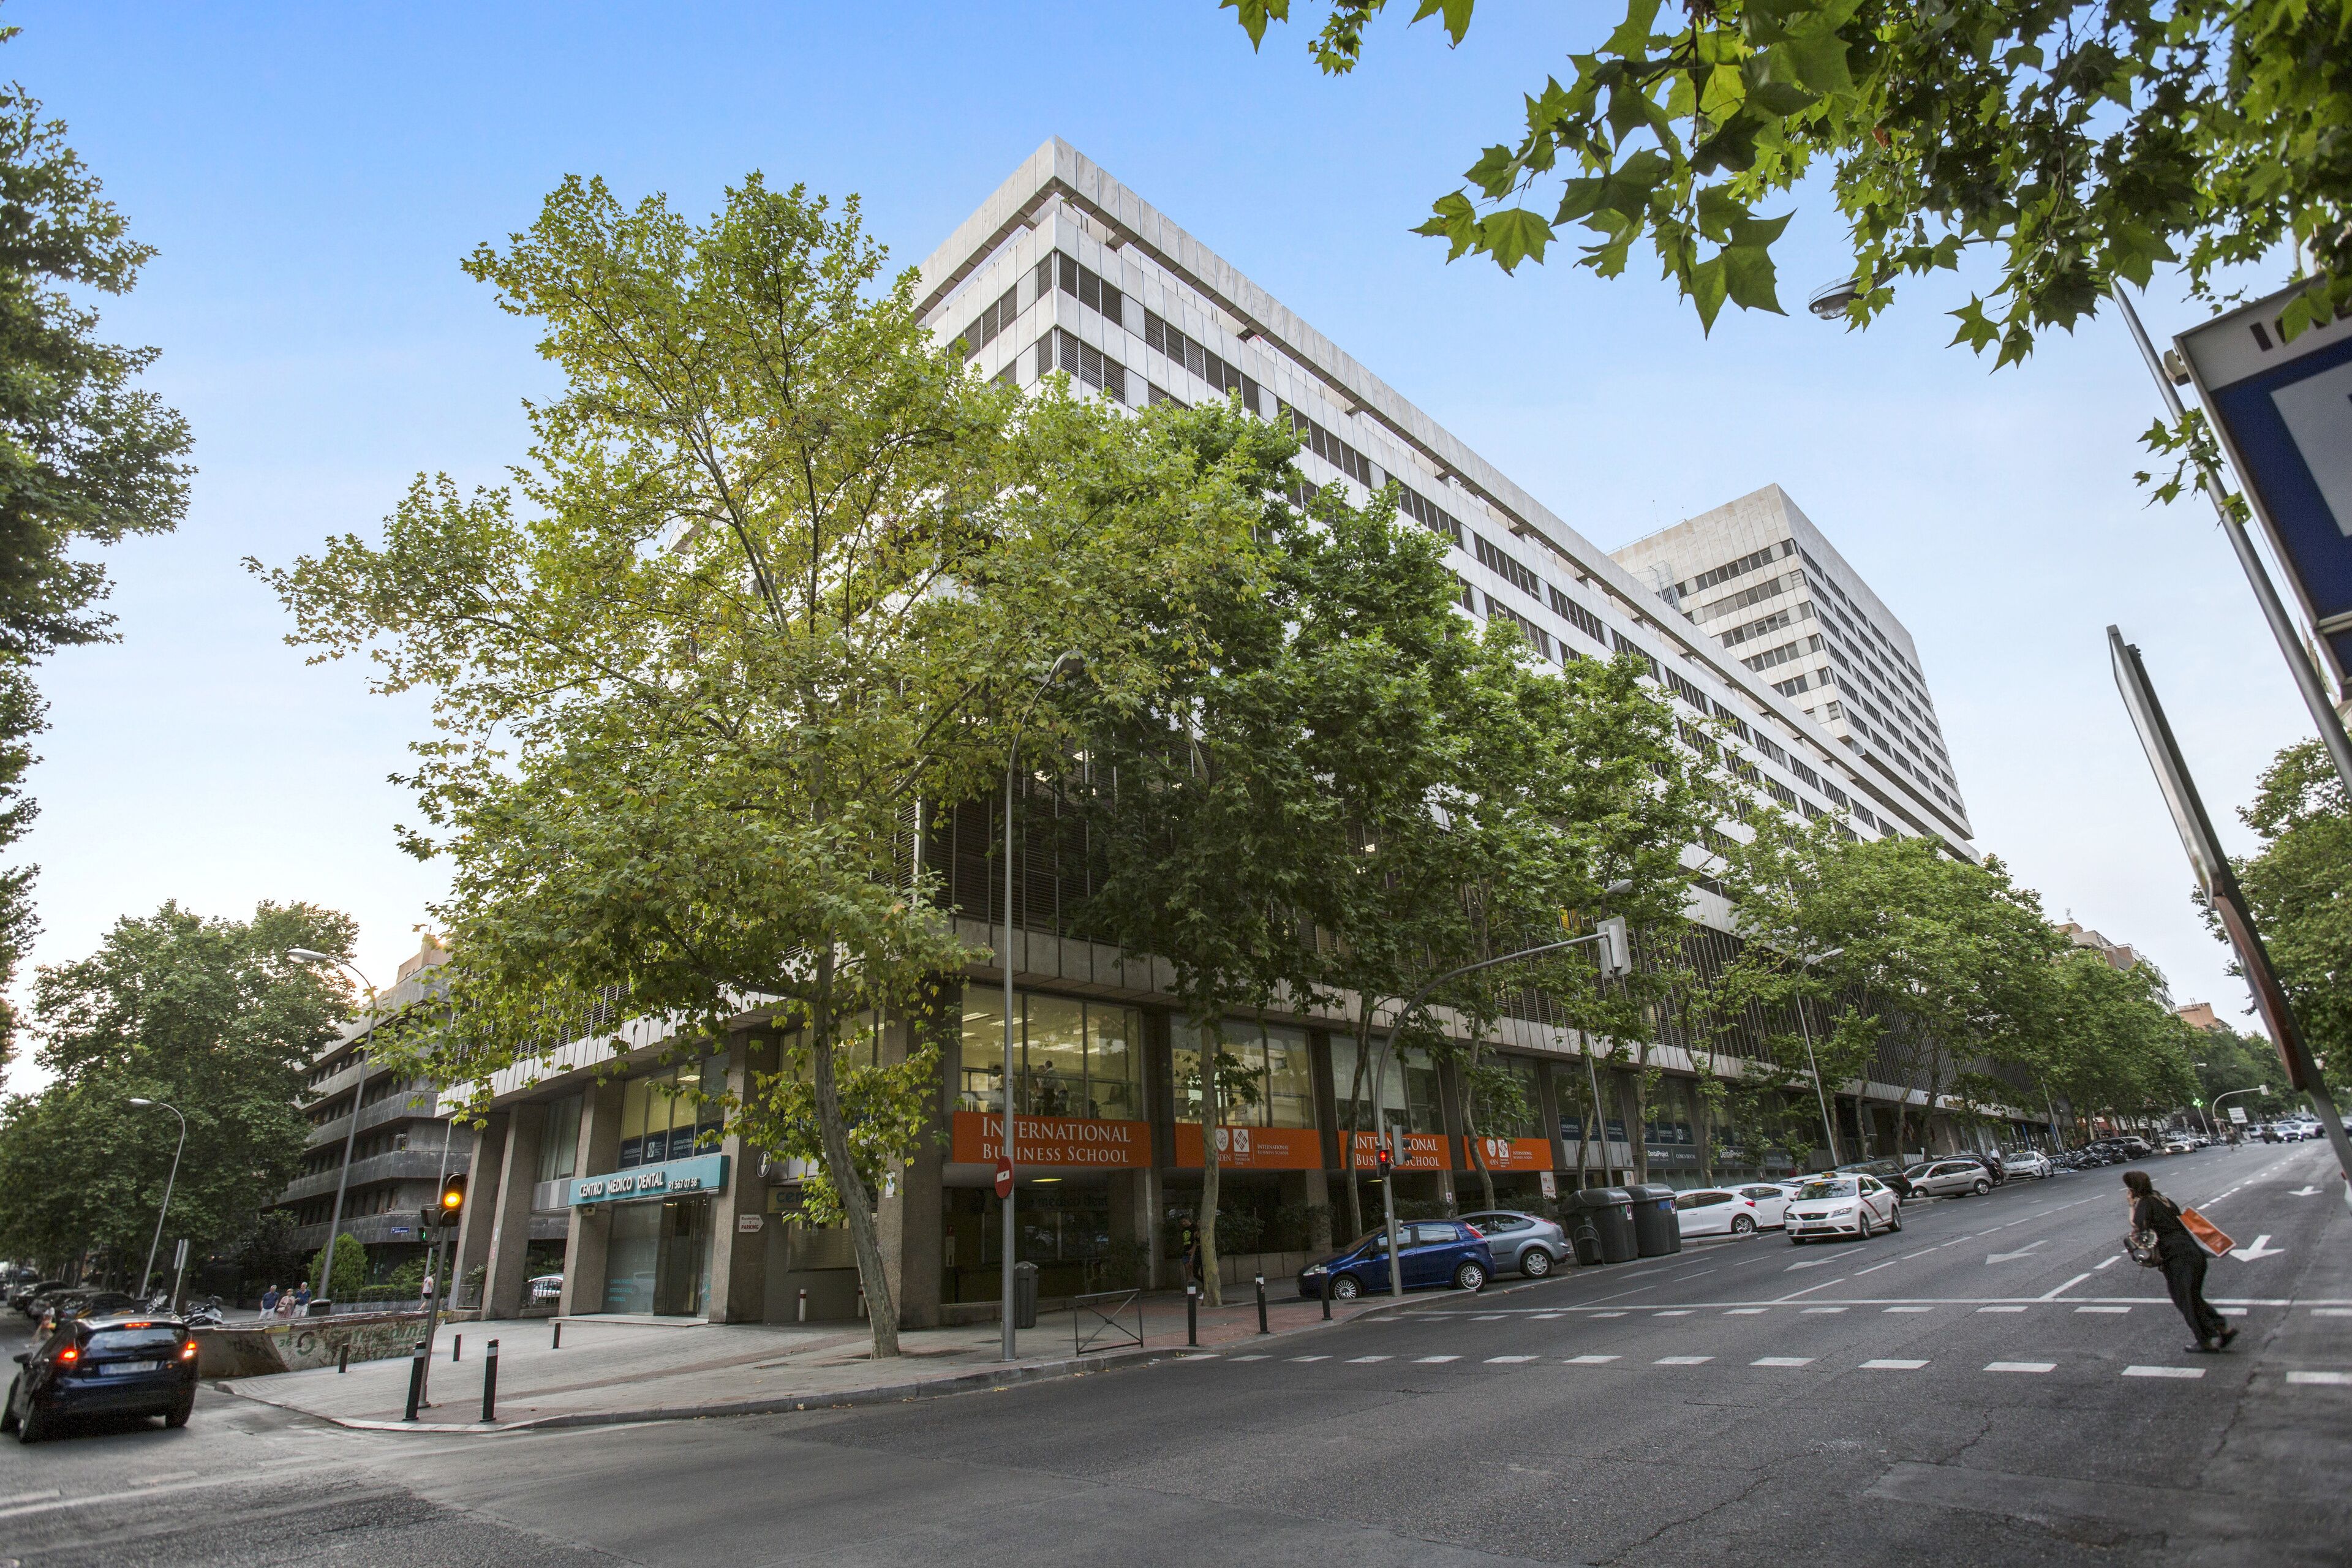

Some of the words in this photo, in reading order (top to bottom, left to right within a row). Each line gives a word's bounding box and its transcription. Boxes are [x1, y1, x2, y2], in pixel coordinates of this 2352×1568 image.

[982, 1117, 1131, 1143] INERNATIONAL
[982, 1143, 1061, 1161] BUINESS
[1068, 1145, 1129, 1163] SCHOOL
[579, 1181, 603, 1197] CENTRO
[606, 1176, 633, 1194] MEDICO
[637, 1171, 663, 1188] DENTAL
[668, 1180, 674, 1190] 91
[674, 1179, 684, 1189] 567
[684, 1178, 690, 1188] 07
[690, 1178, 697, 1188] 58
